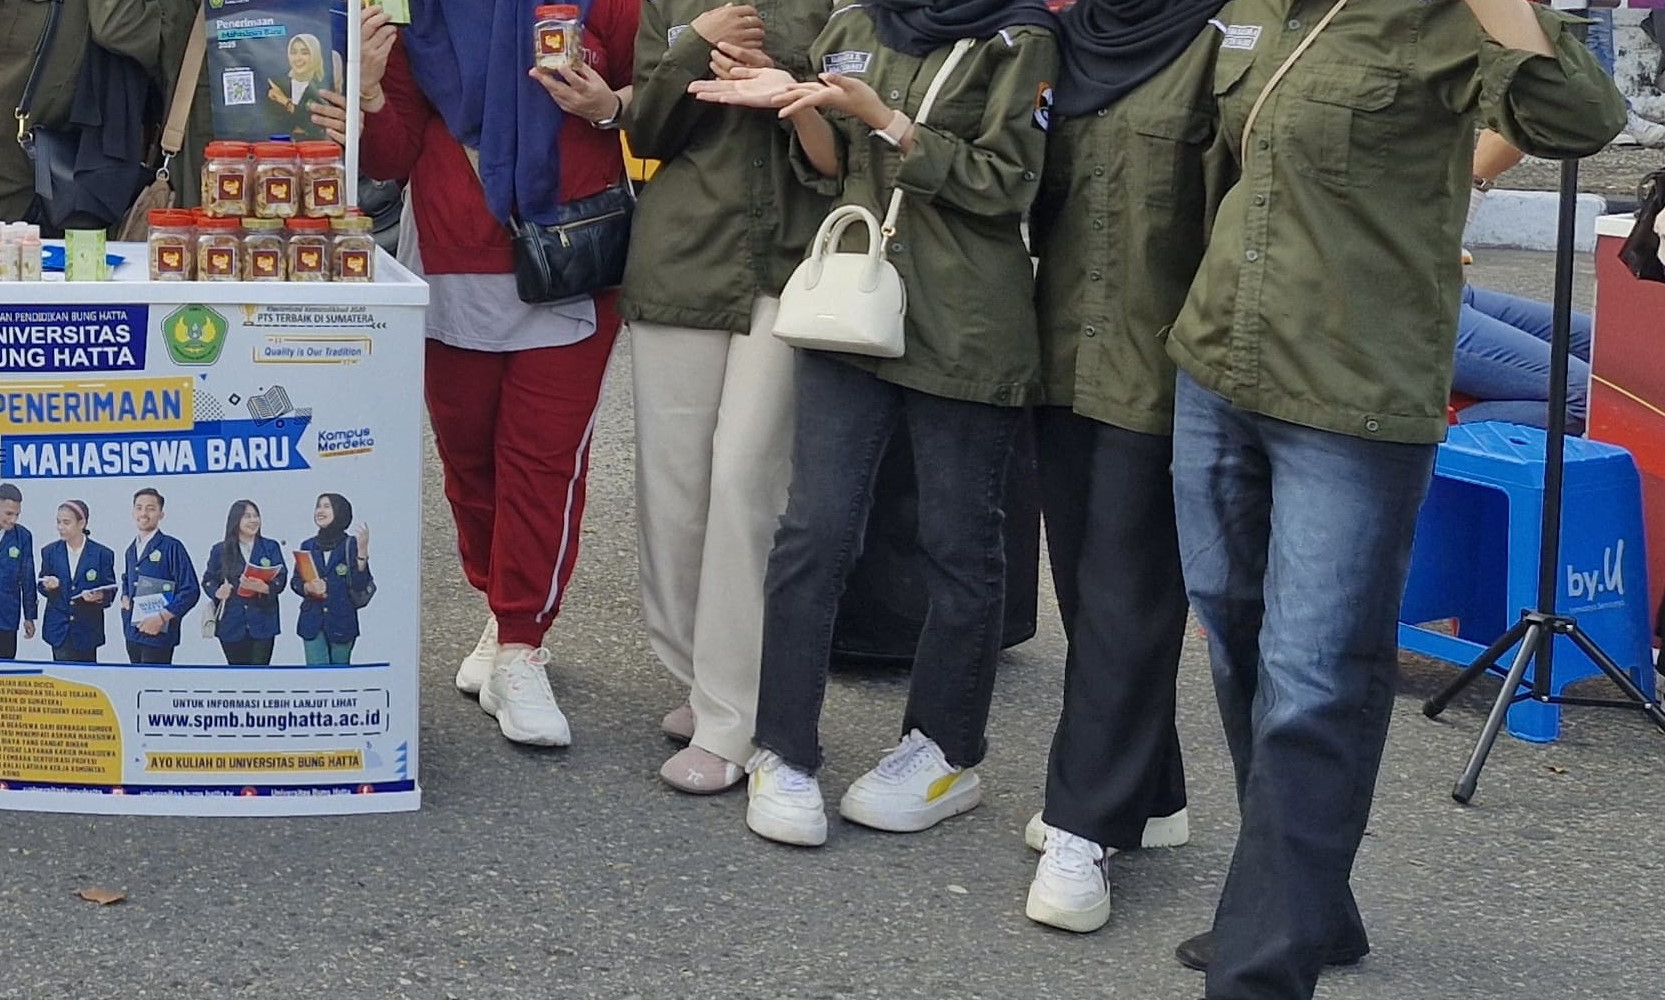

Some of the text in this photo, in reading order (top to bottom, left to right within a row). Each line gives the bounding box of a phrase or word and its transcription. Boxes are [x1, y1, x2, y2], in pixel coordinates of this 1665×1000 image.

[216, 18, 274, 29] Penerimaan
[15, 311, 69, 322] PENDIDIKAN
[72, 311, 96, 322] BUNG
[100, 310, 127, 320] HATTA
[258, 313, 374, 323] PTS TERBAIK DI SUMATERA
[53, 346, 135, 366] HATTA
[265, 347, 361, 357] Quality is Our Tradition
[318, 427, 370, 443] Kampus
[317, 436, 374, 452] Merdeka
[12, 436, 289, 476] MAHASISWA BARU
[1567, 538, 1626, 598] by.U
[173, 698, 357, 708] UNTUK INFORMASI LEBIH LANJUT LIHAT
[148, 710, 380, 731] www.spmb.bunghatta.ac.id
[151, 757, 359, 768] AYO KULIAH DI UNIVERSITAS BUNG HATTA
